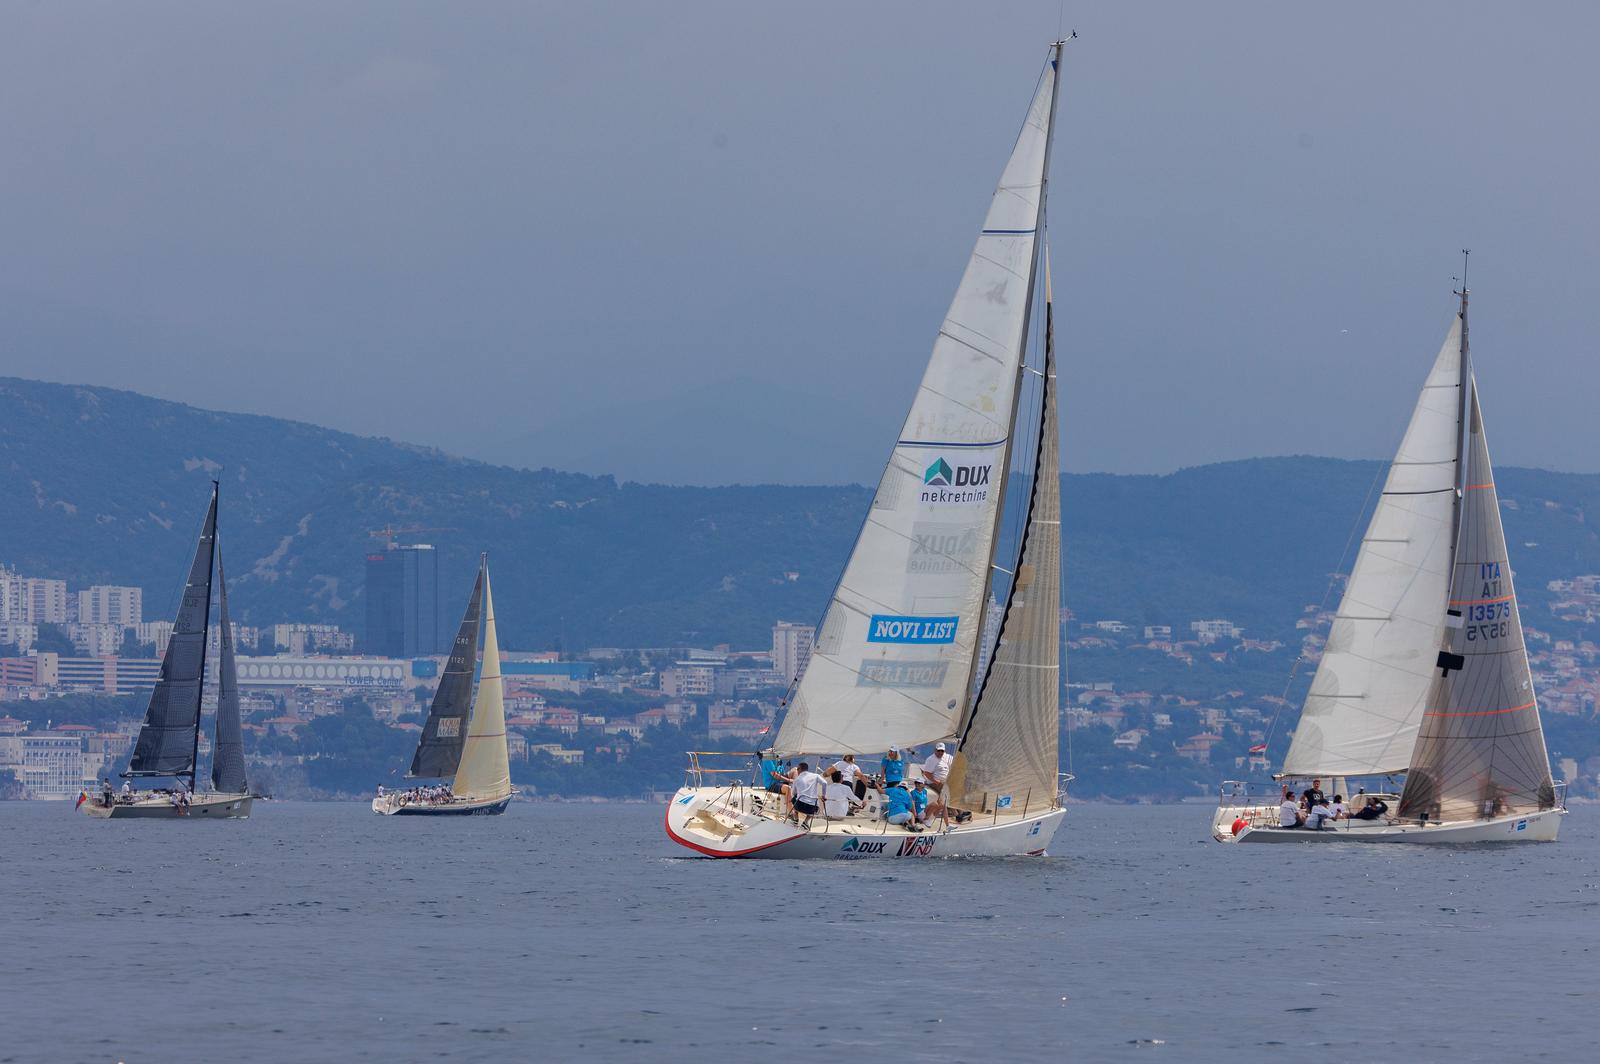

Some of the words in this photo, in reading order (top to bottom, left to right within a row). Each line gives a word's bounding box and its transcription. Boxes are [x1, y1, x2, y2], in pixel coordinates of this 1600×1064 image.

[955, 465, 992, 487] DUX
[921, 489, 987, 503] nekretnine
[1481, 562, 1501, 580] ITA
[1468, 602, 1510, 621] 13575
[875, 621, 919, 639] NOVI
[922, 621, 955, 639] LIST
[343, 675, 374, 685] TOWER
[857, 841, 887, 854] DUX
